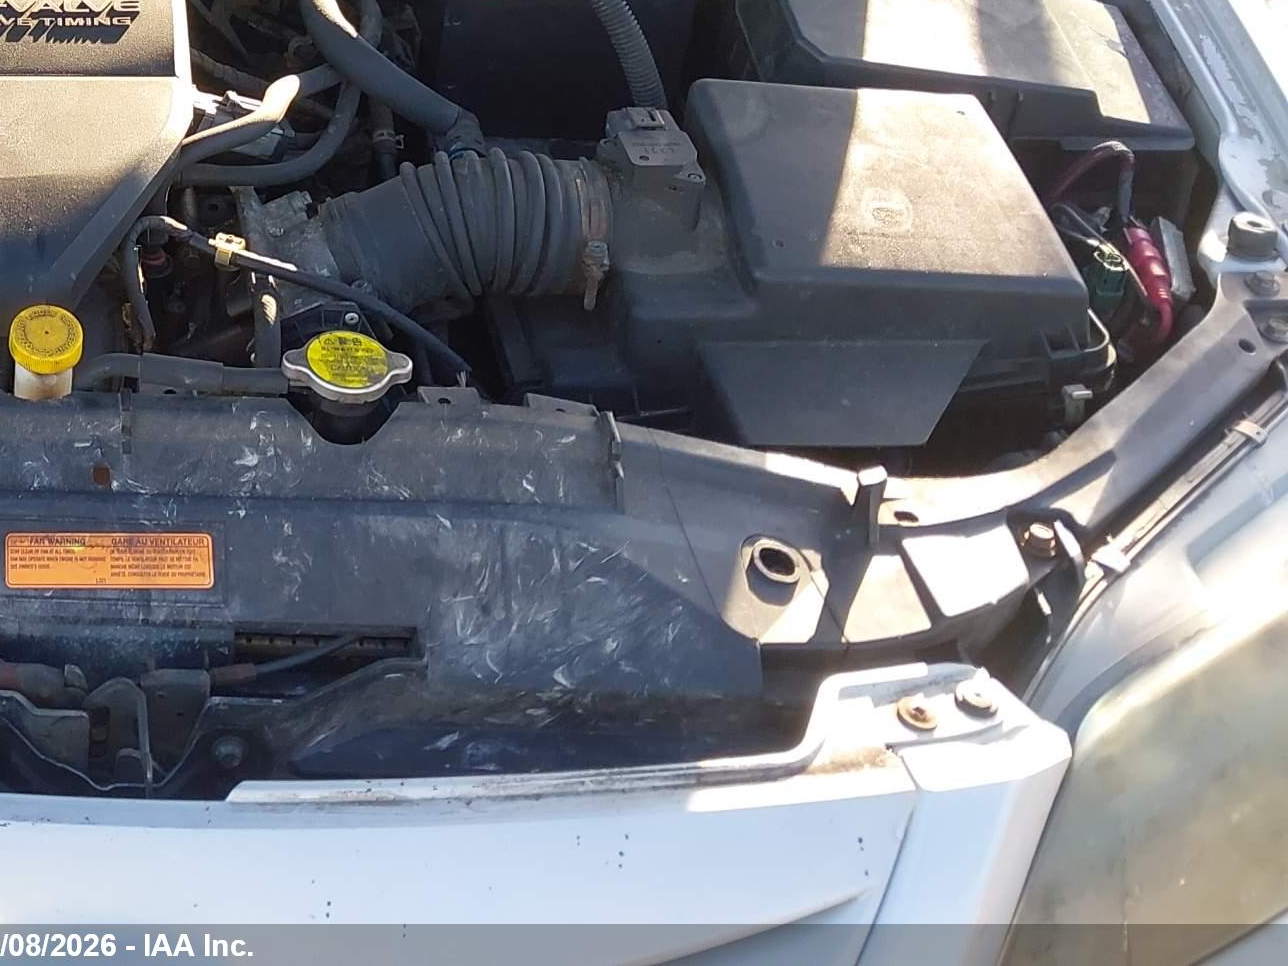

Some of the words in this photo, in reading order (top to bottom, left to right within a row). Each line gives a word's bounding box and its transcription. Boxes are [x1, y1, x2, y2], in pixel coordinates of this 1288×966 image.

[39, 16, 131, 27] TIMING
[47, 537, 86, 545] WARNING
[136, 537, 148, 545] AU
[149, 537, 205, 545] VENTILATEUR
